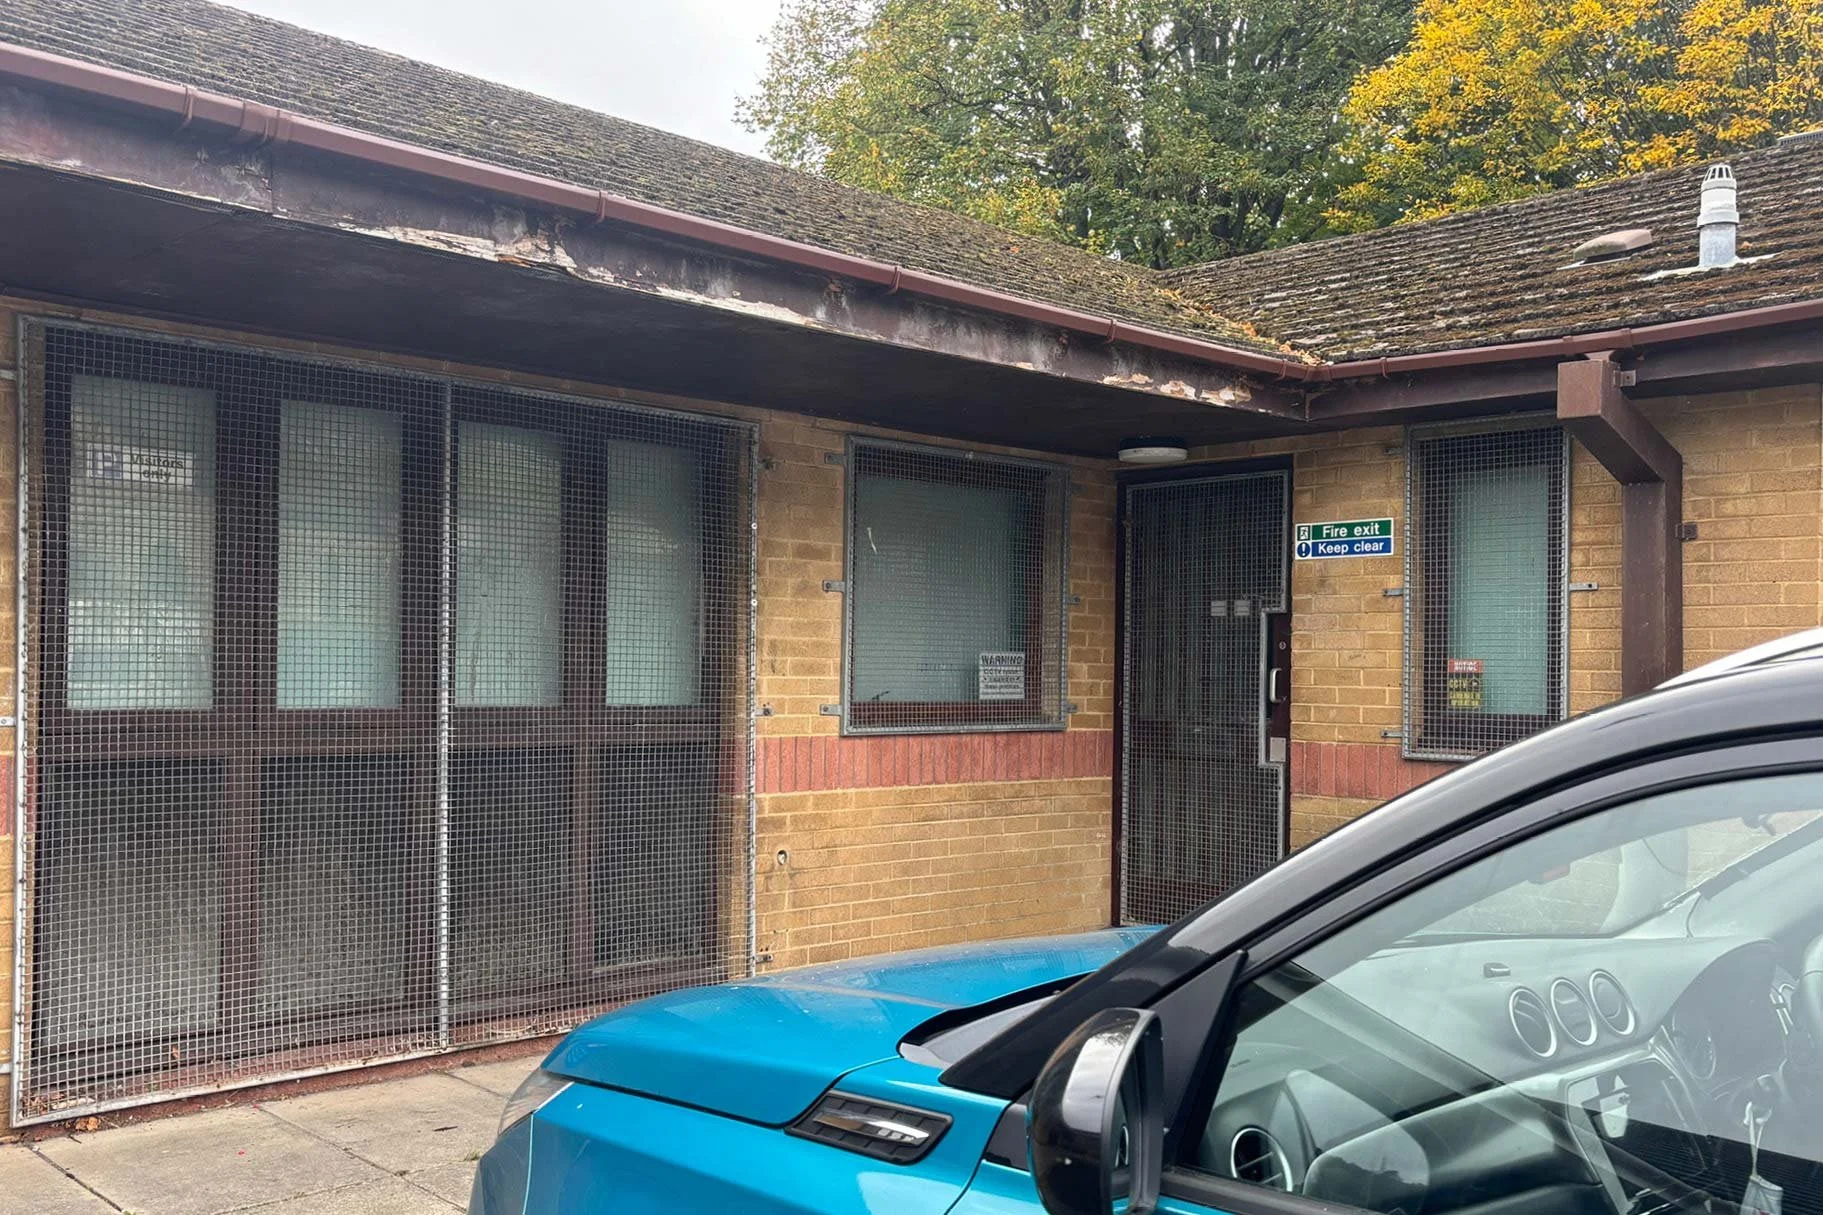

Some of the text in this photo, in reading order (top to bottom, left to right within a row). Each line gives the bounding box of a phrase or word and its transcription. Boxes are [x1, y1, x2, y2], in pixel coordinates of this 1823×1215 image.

[97, 451, 117, 475] P
[131, 453, 184, 469] Visitors
[142, 468, 172, 481] only
[1322, 522, 1380, 538] Fire exit
[1318, 540, 1385, 555] Keep clear
